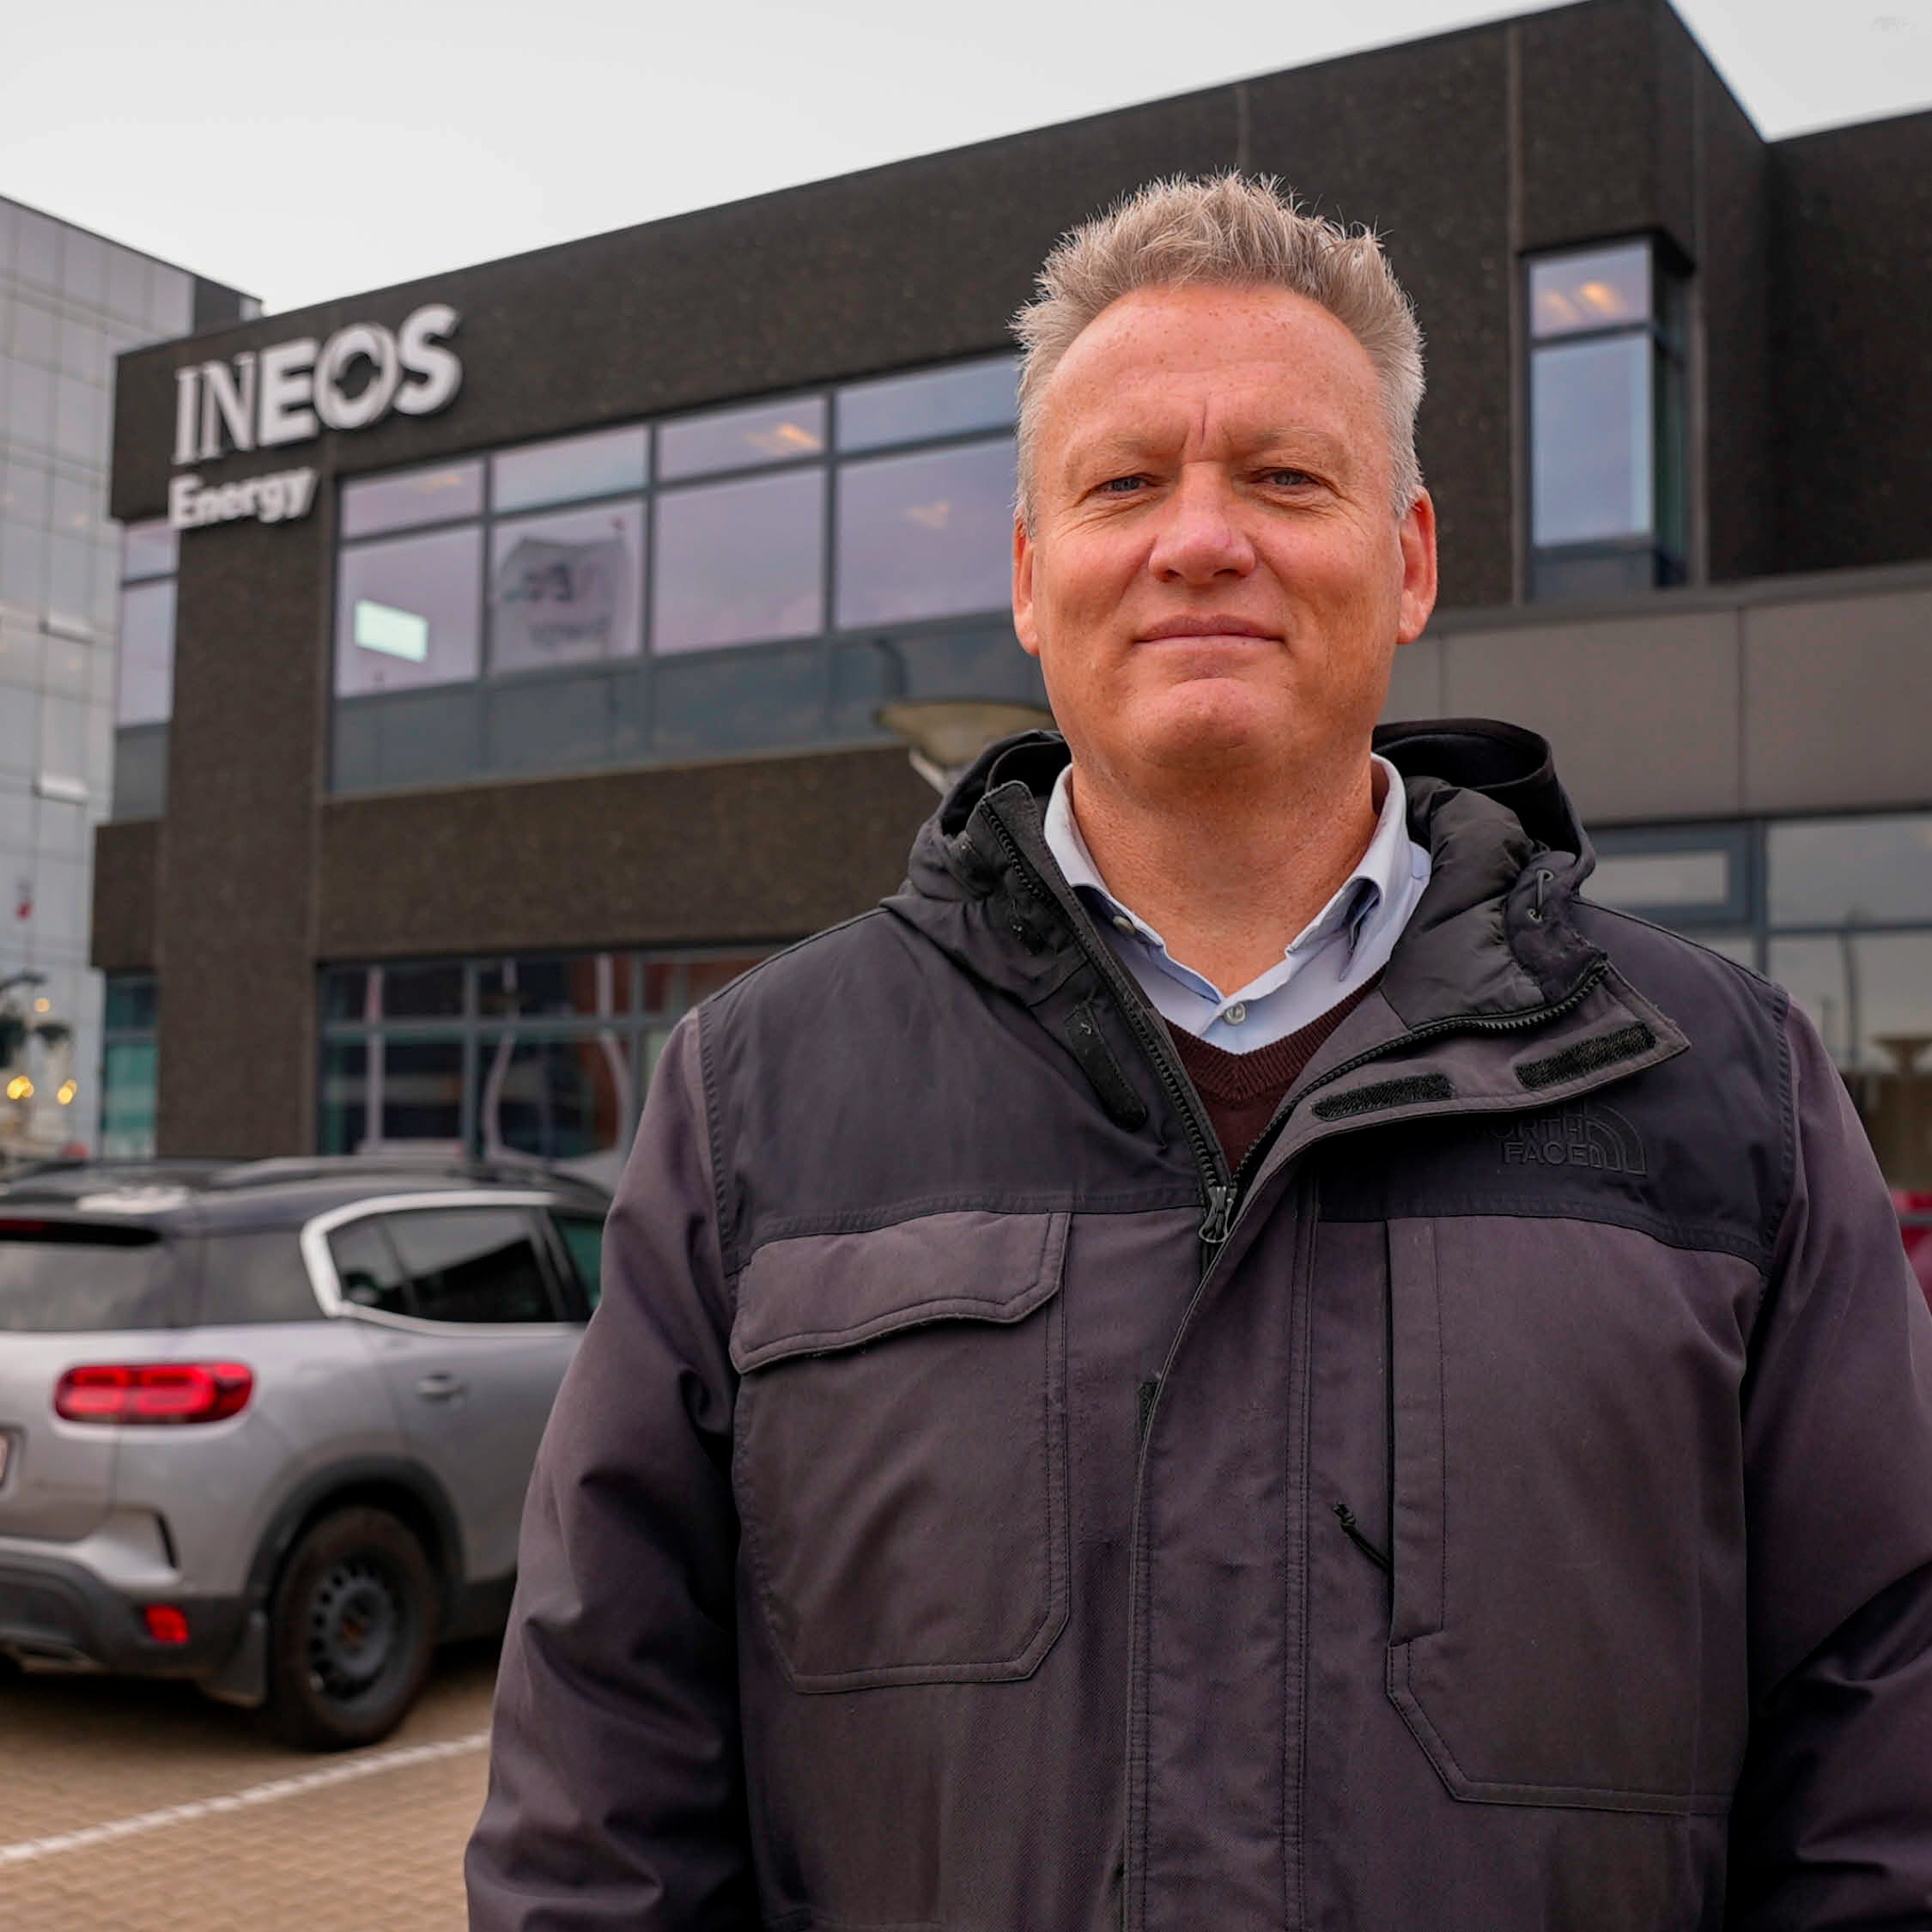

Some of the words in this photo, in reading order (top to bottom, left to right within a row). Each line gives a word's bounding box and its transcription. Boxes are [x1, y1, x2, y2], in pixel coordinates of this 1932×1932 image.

[173, 303, 464, 465] INEOS
[168, 467, 319, 530] Energy
[1488, 1115, 1588, 1142] ORTH
[1503, 1140, 1589, 1165] FACE
